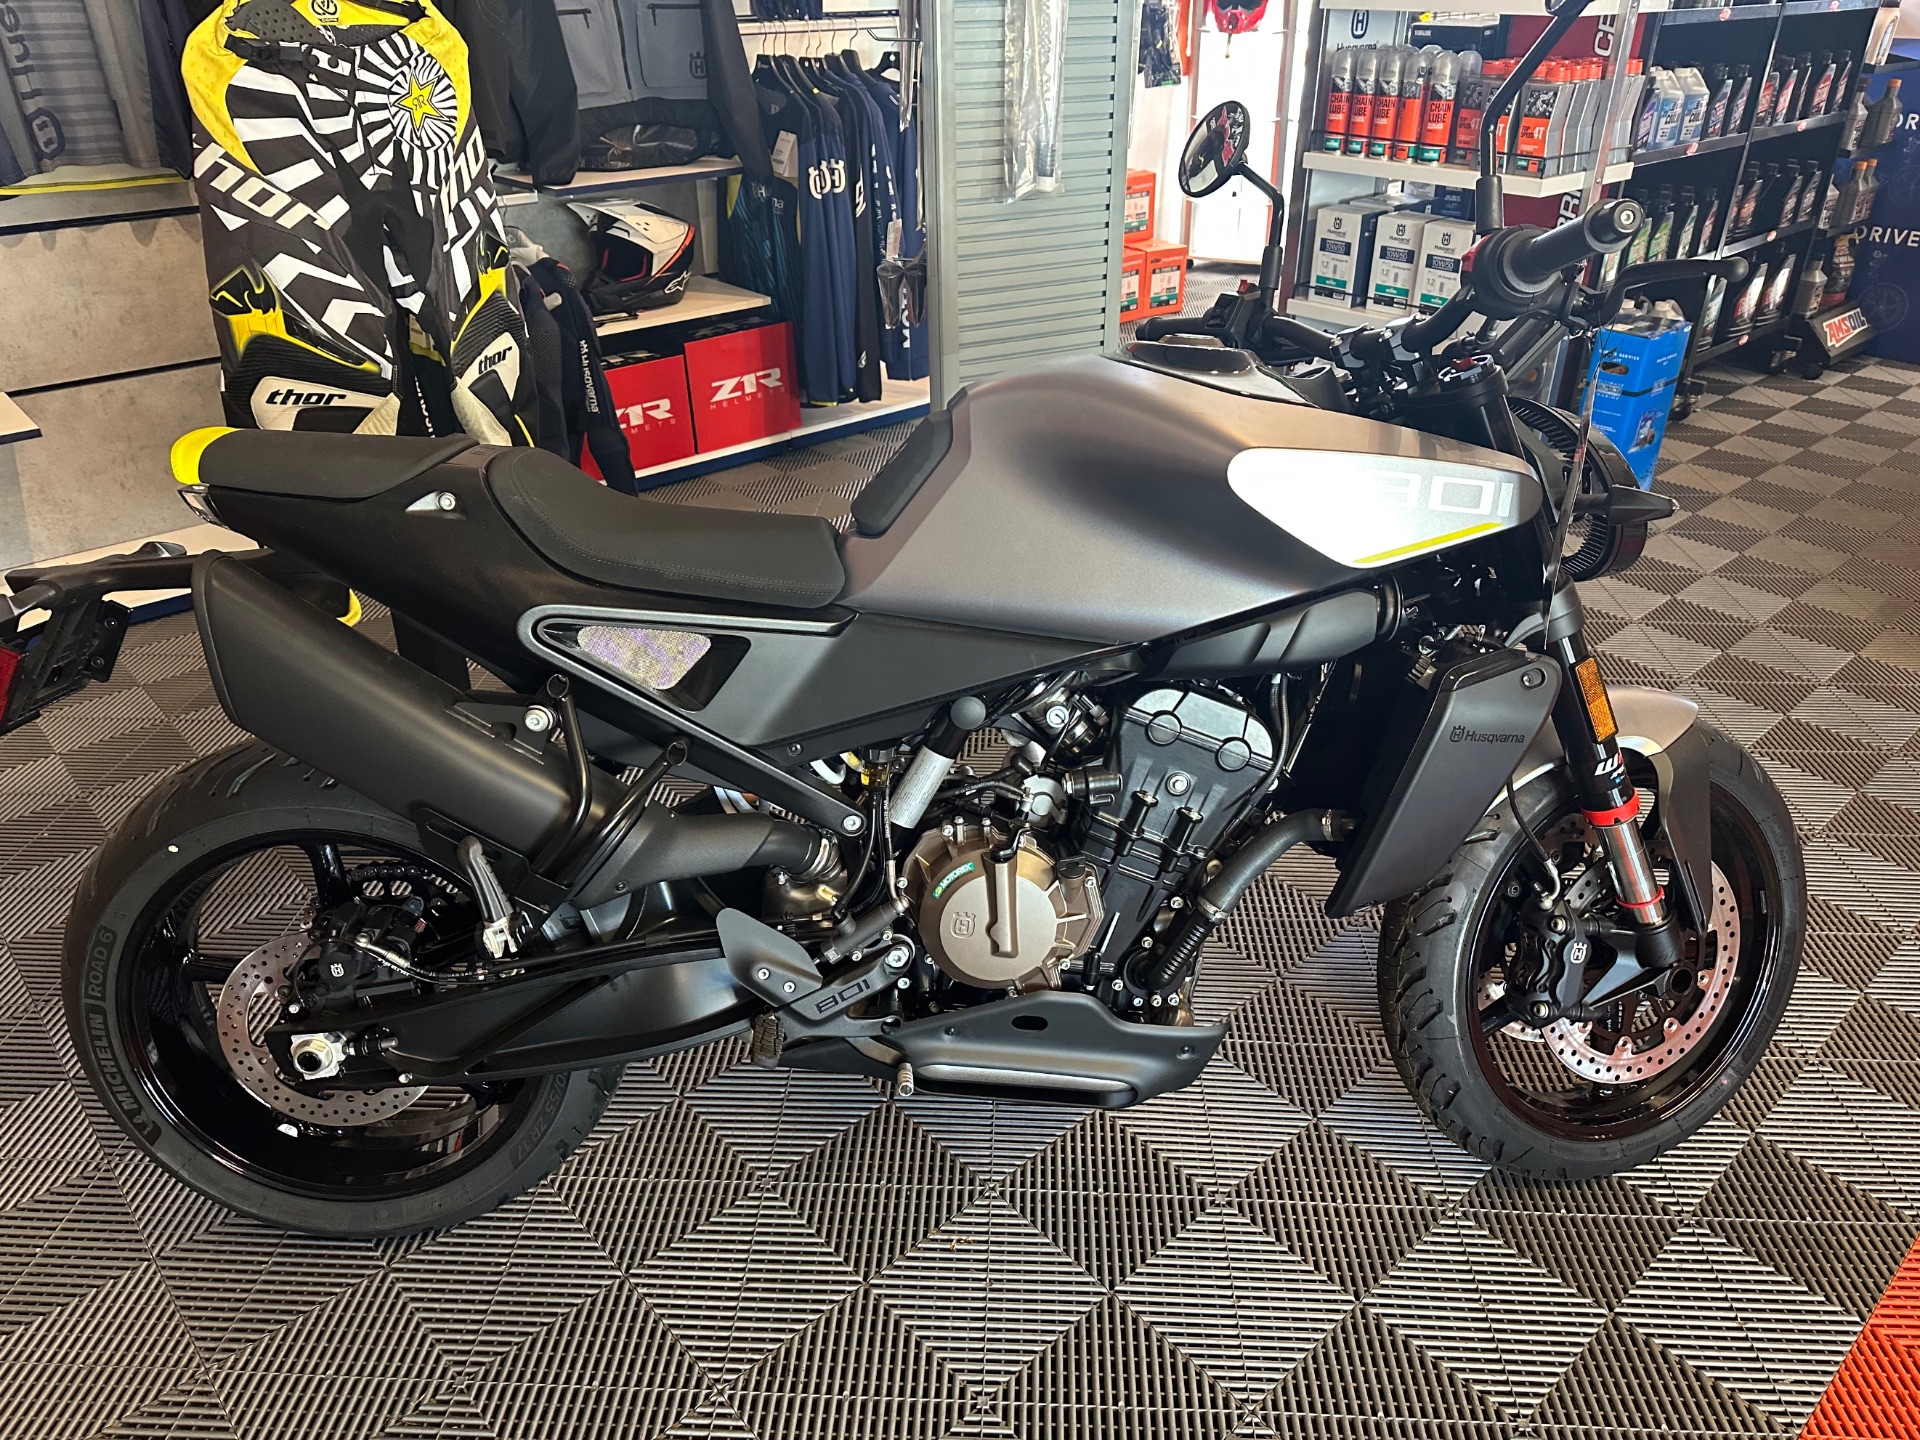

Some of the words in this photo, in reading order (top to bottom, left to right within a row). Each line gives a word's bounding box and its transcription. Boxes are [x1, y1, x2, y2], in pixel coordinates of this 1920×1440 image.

[1330, 94, 1350, 104] CHAIN
[1329, 104, 1347, 114] LUBE
[1430, 102, 1452, 113] CHAIN
[1428, 113, 1448, 123] LUBE
[1533, 126, 1546, 140] 4T
[193, 138, 332, 231] hor
[1386, 250, 1408, 260] 10W/50
[1431, 259, 1454, 269] 10W/50
[1825, 310, 1868, 343] AMSOIL
[478, 345, 513, 375] thor
[265, 389, 347, 406] thor
[710, 387, 785, 411] HELMETS
[1464, 730, 1525, 745] Husqvarna
[941, 865, 973, 890] MOTOREX
[99, 930, 114, 943] 6
[88, 948, 108, 997] ROAD
[814, 978, 871, 1014] 801
[88, 1012, 139, 1112] MICHELIN
